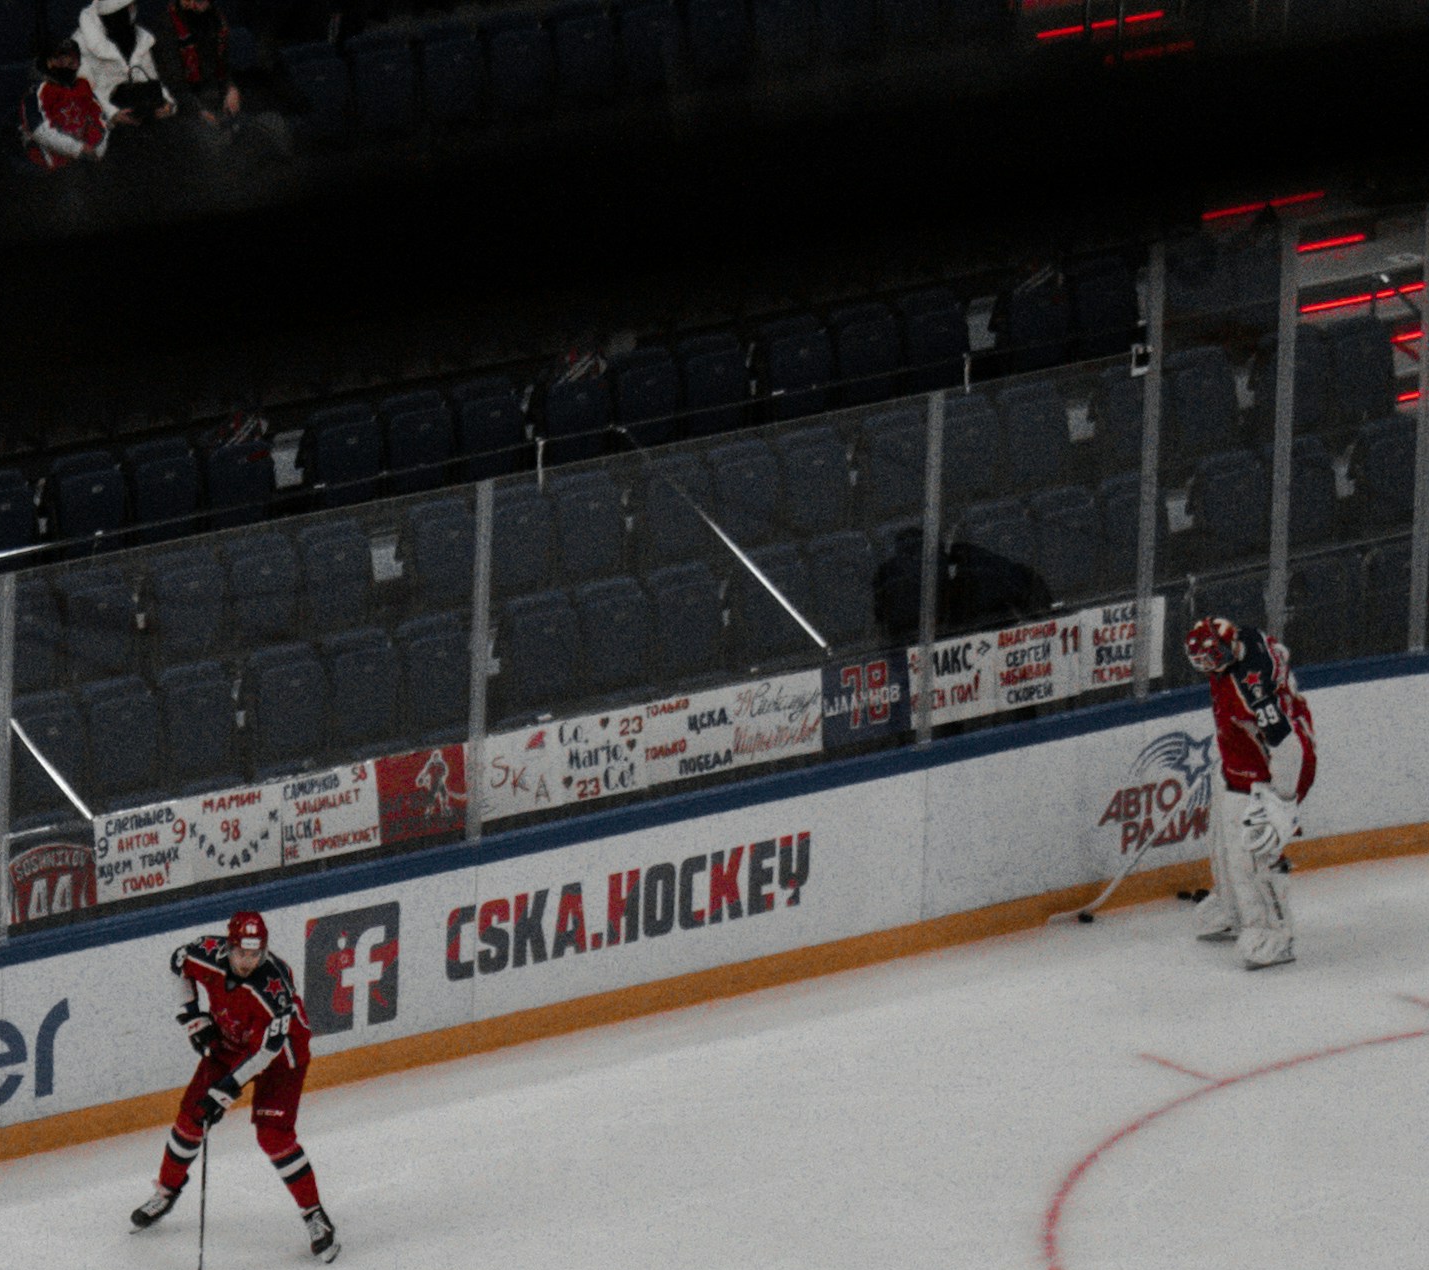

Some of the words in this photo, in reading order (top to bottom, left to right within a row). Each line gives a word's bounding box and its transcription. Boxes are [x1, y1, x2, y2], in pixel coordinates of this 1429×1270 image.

[1060, 624, 1079, 656] 11
[1093, 622, 1136, 647] ВСЕГД
[1095, 643, 1132, 666] БУДЕ
[1091, 663, 1133, 685] ПЕРВЫ
[840, 660, 890, 730] 78
[618, 714, 643, 737] 23
[201, 789, 262, 815] МАМИН
[576, 776, 601, 800] 23
[1097, 778, 1183, 827] АВТО
[116, 831, 160, 854] АНТОН
[172, 818, 187, 844] 9
[220, 818, 242, 844] 98
[1120, 807, 1209, 855] РАДИ
[27, 873, 74, 920] 44
[445, 831, 812, 983] CSKA.HOCKEY
